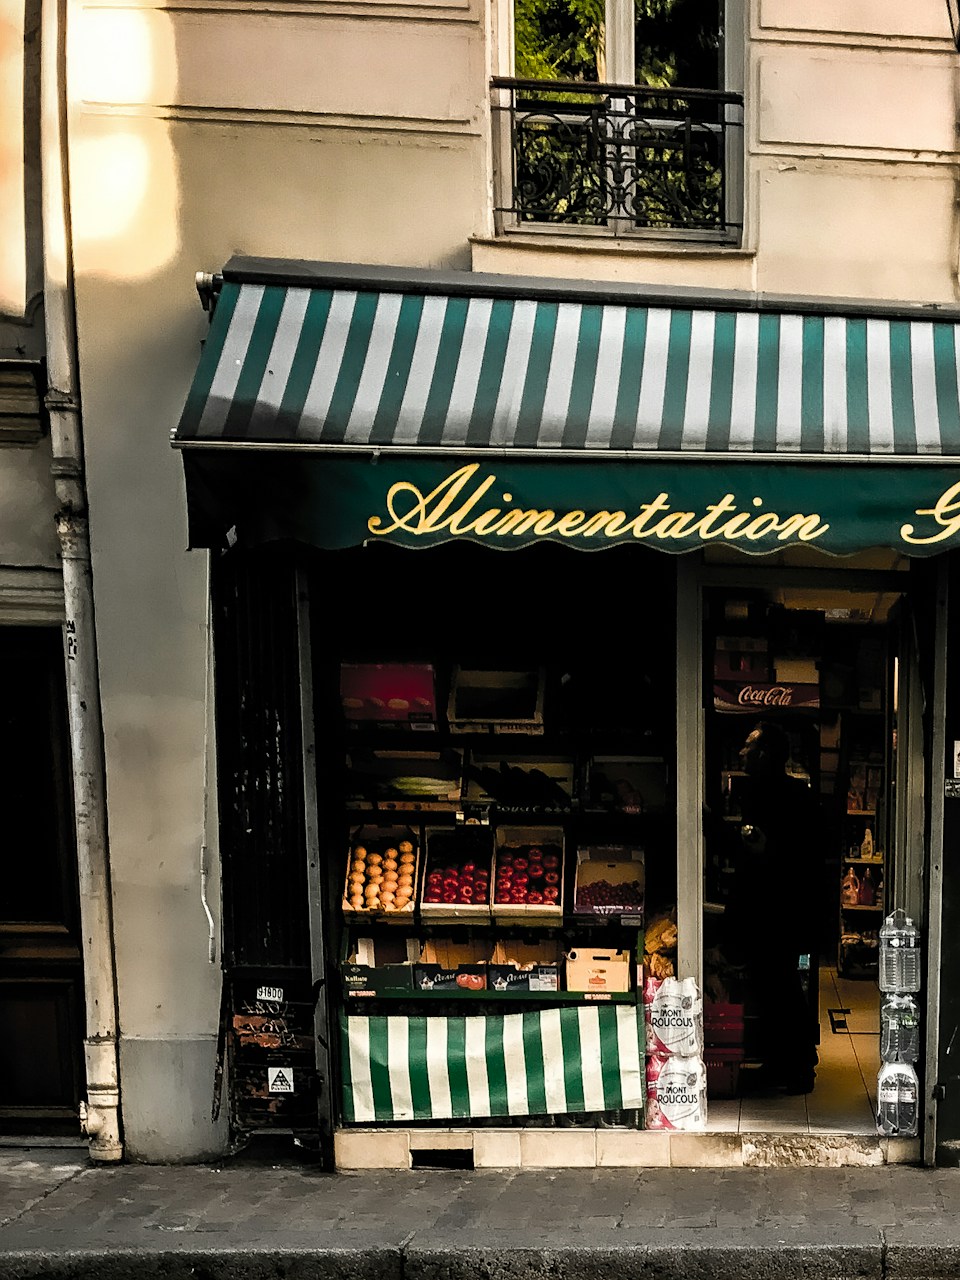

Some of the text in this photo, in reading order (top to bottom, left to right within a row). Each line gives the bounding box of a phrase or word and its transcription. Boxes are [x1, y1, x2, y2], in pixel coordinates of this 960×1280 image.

[368, 463, 829, 541] Alimentation
[652, 1017, 693, 1028] ROUCOUS
[657, 1094, 698, 1105] ROUCOUS
